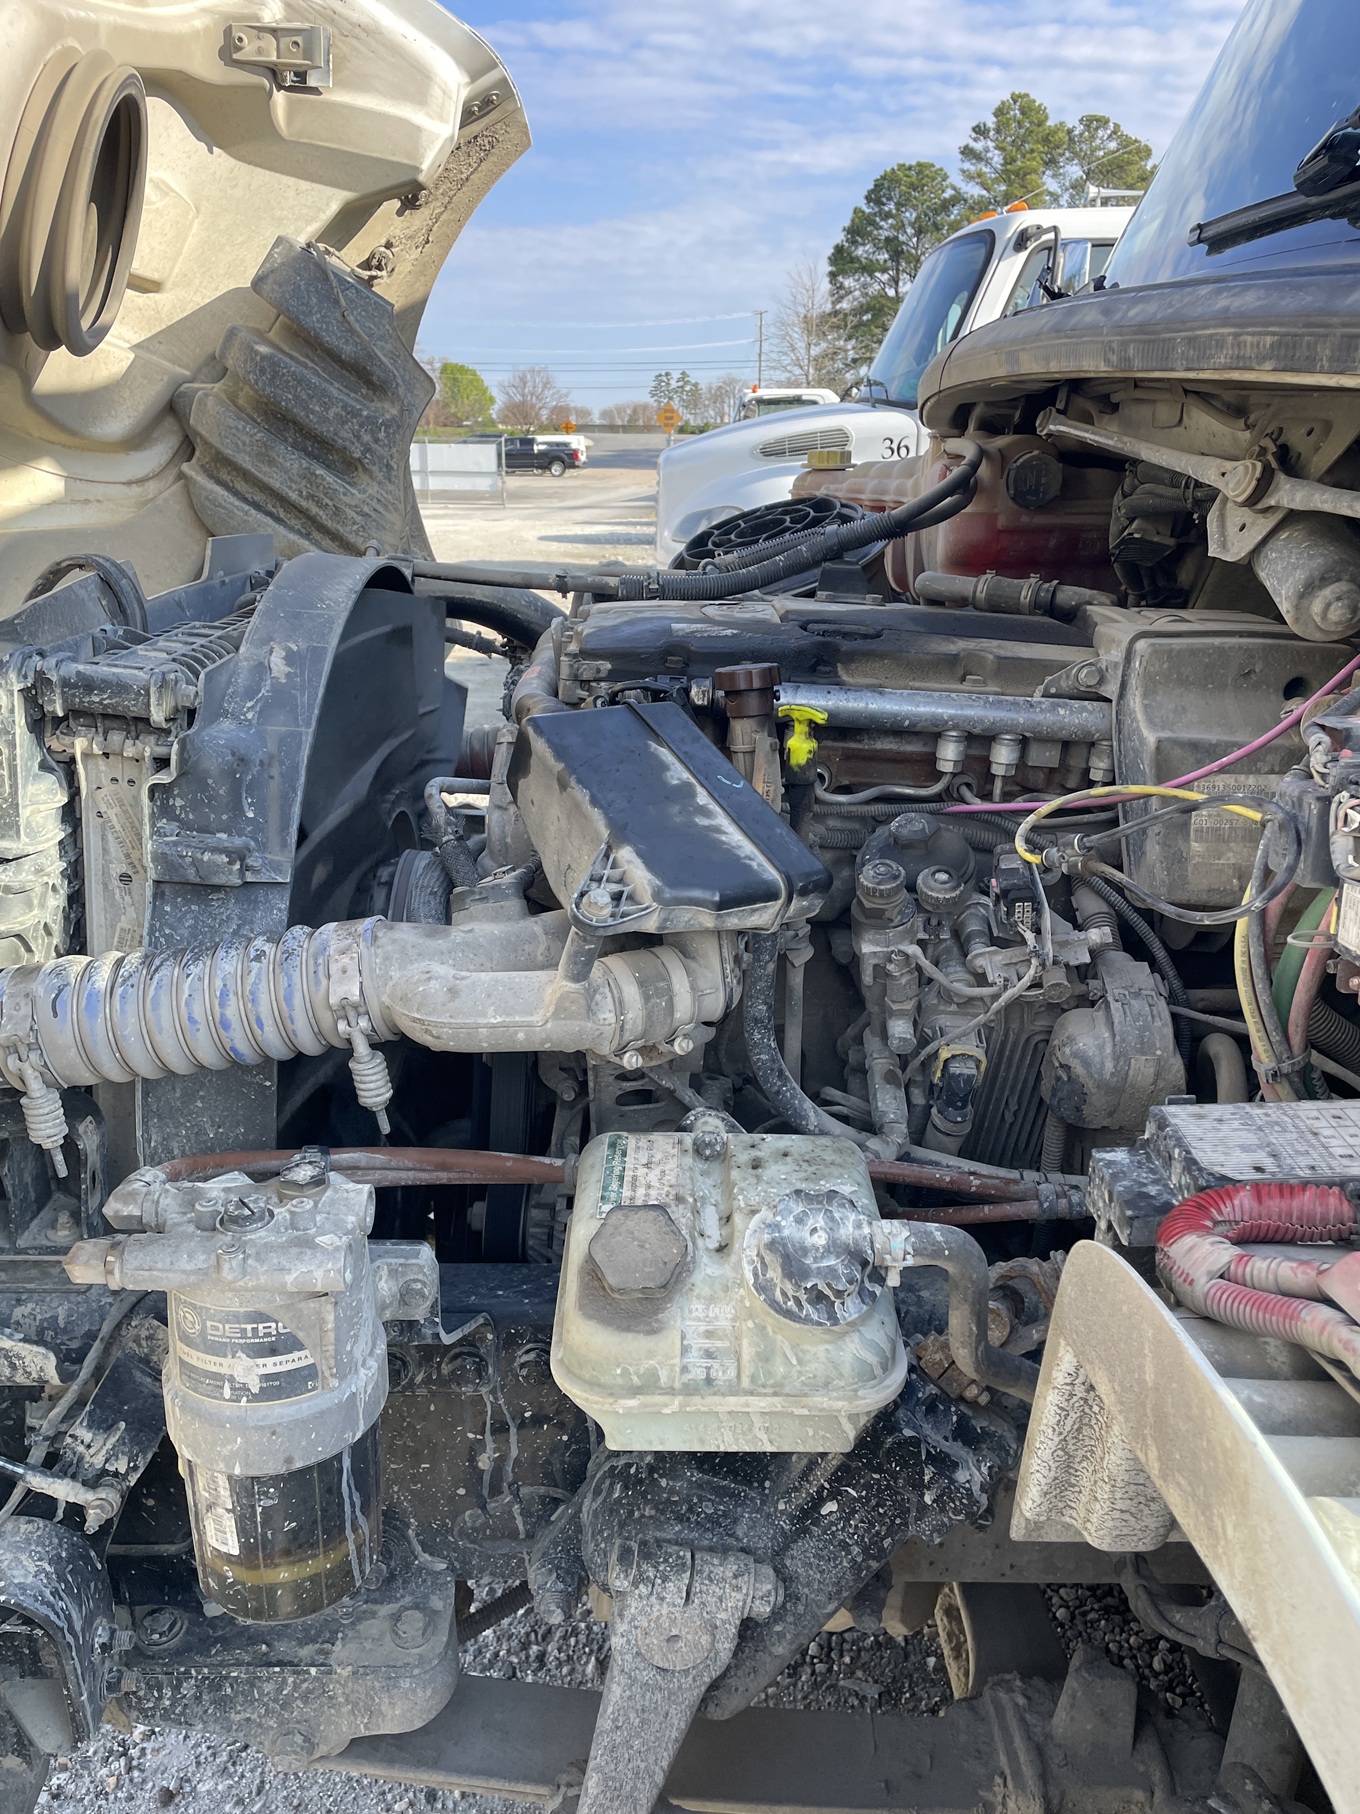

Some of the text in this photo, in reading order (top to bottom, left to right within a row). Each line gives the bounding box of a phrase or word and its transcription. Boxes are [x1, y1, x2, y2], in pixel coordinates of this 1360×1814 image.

[881, 436, 910, 460] 36
[207, 1335, 276, 1344] DEMAND PERFORMANCE
[196, 1356, 224, 1368] FILTER
[272, 1354, 313, 1368] SEPARA
